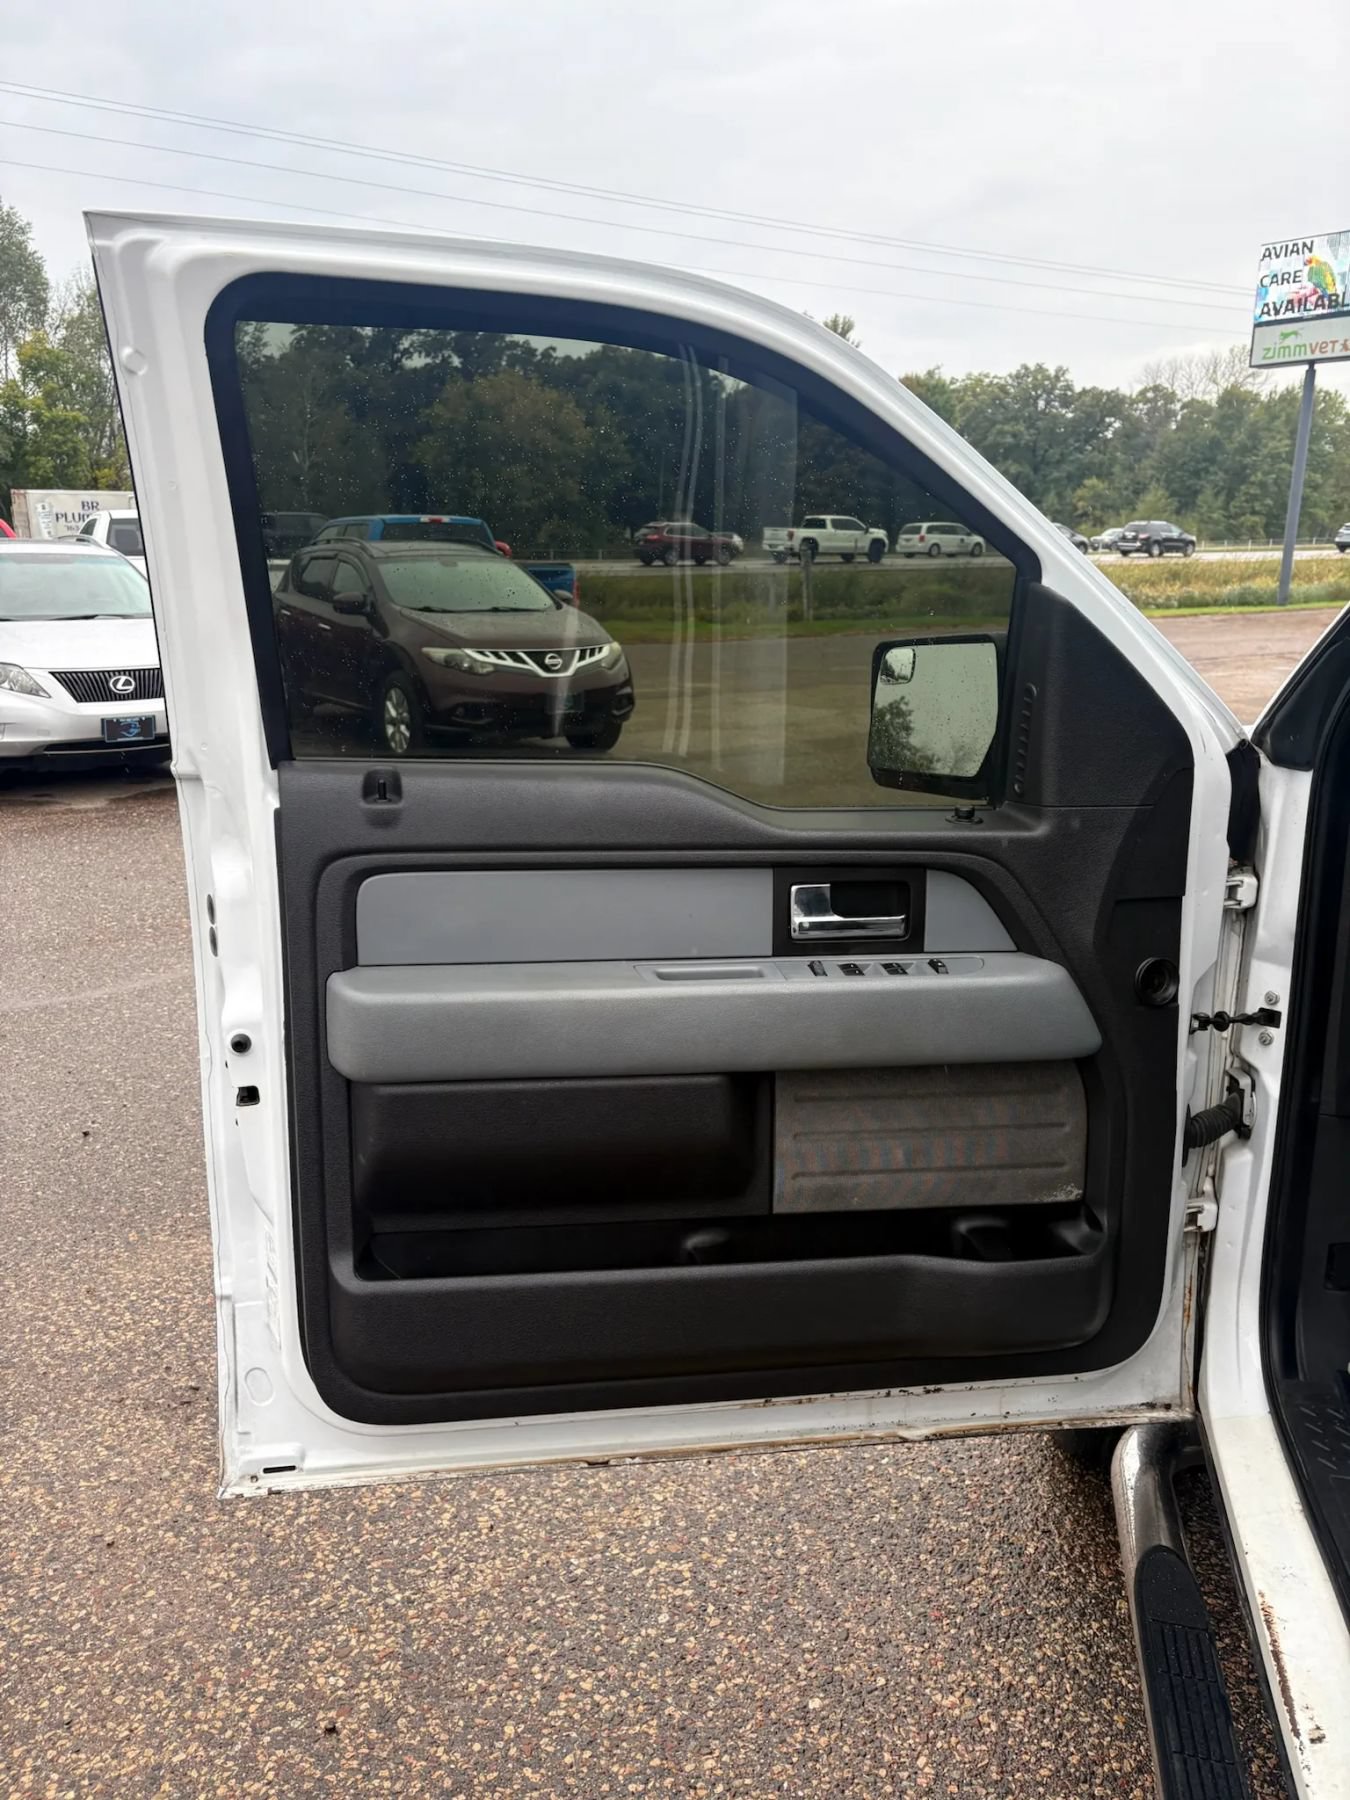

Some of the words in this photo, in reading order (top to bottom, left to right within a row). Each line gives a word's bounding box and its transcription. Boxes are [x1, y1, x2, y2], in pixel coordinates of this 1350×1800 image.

[1260, 240, 1314, 262] AVIAN
[1260, 270, 1303, 288] CARE
[81, 501, 100, 511] BR
